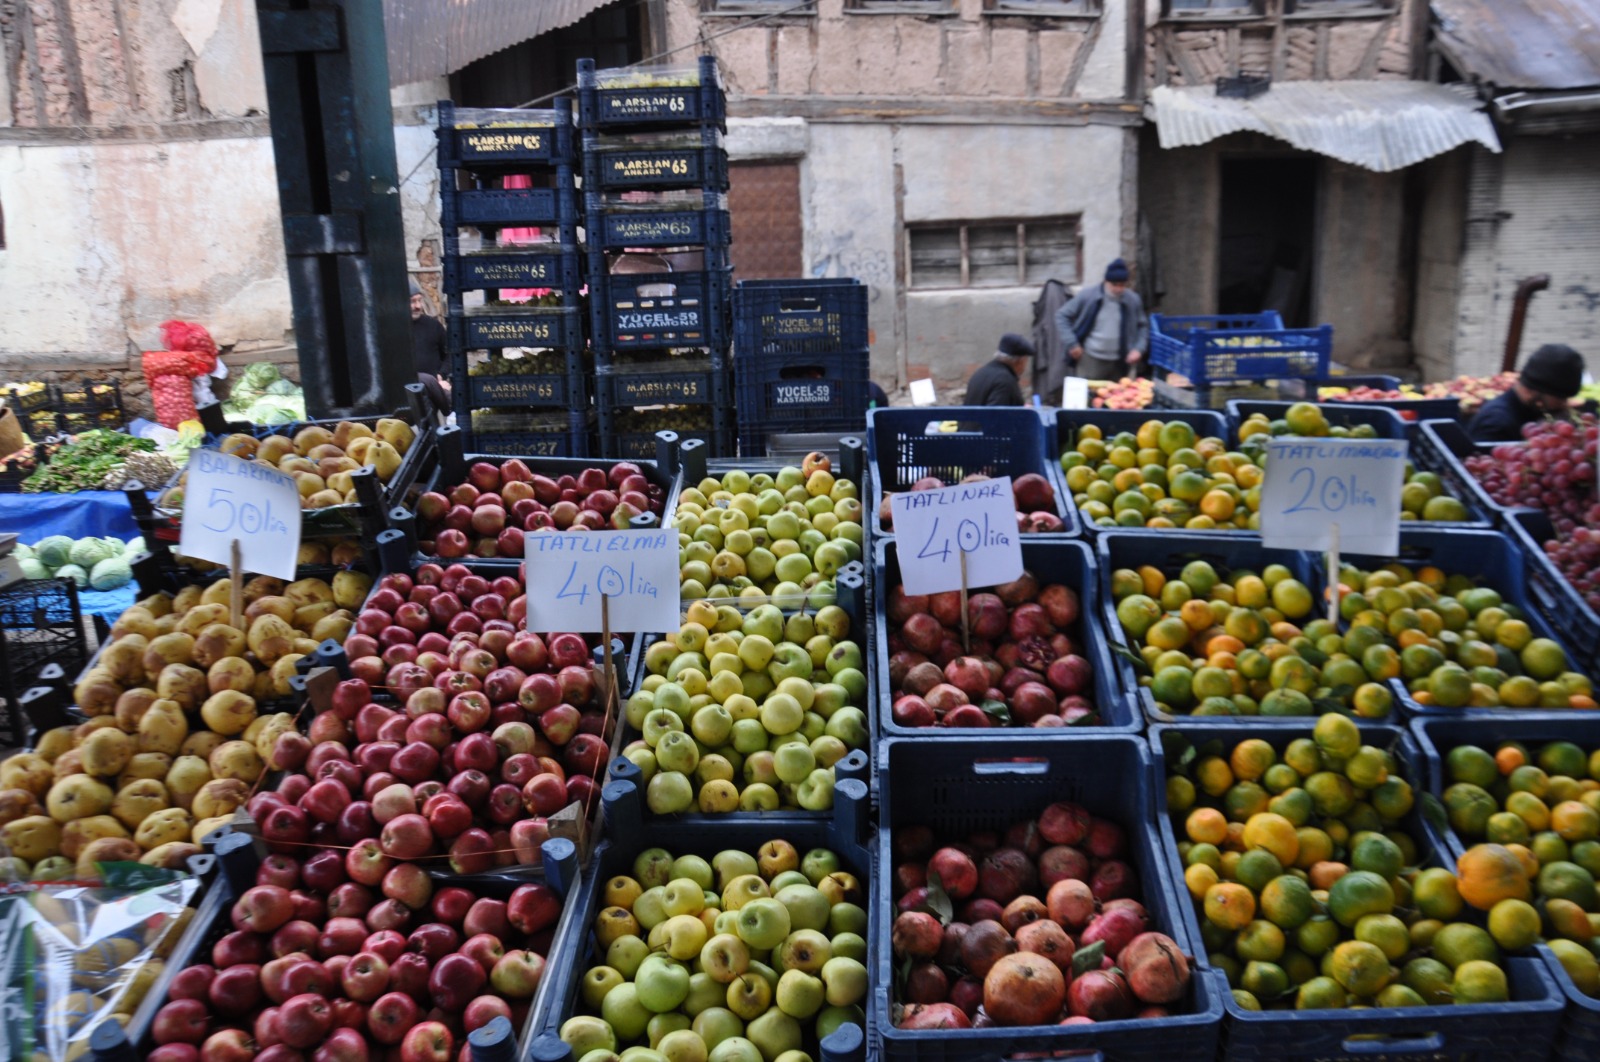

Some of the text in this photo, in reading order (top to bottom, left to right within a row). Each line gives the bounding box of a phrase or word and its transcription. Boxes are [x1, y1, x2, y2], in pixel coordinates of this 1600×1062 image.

[611, 96, 685, 112] M.ARSLAN 65
[614, 159, 688, 174] M.ARSLAN 65
[623, 168, 662, 176] ANKARA
[669, 221, 691, 235] 65
[530, 264, 546, 279] 65
[618, 311, 699, 324] YÜCEL-59
[478, 323, 549, 338] M.ARSLAN 65
[487, 332, 525, 340] ANKARA
[482, 383, 553, 398] M.ARSLAN 65
[626, 382, 698, 396] M.ARSLAN 65
[776, 385, 830, 397] YÜCEL-59
[537, 441, 558, 456] 27
